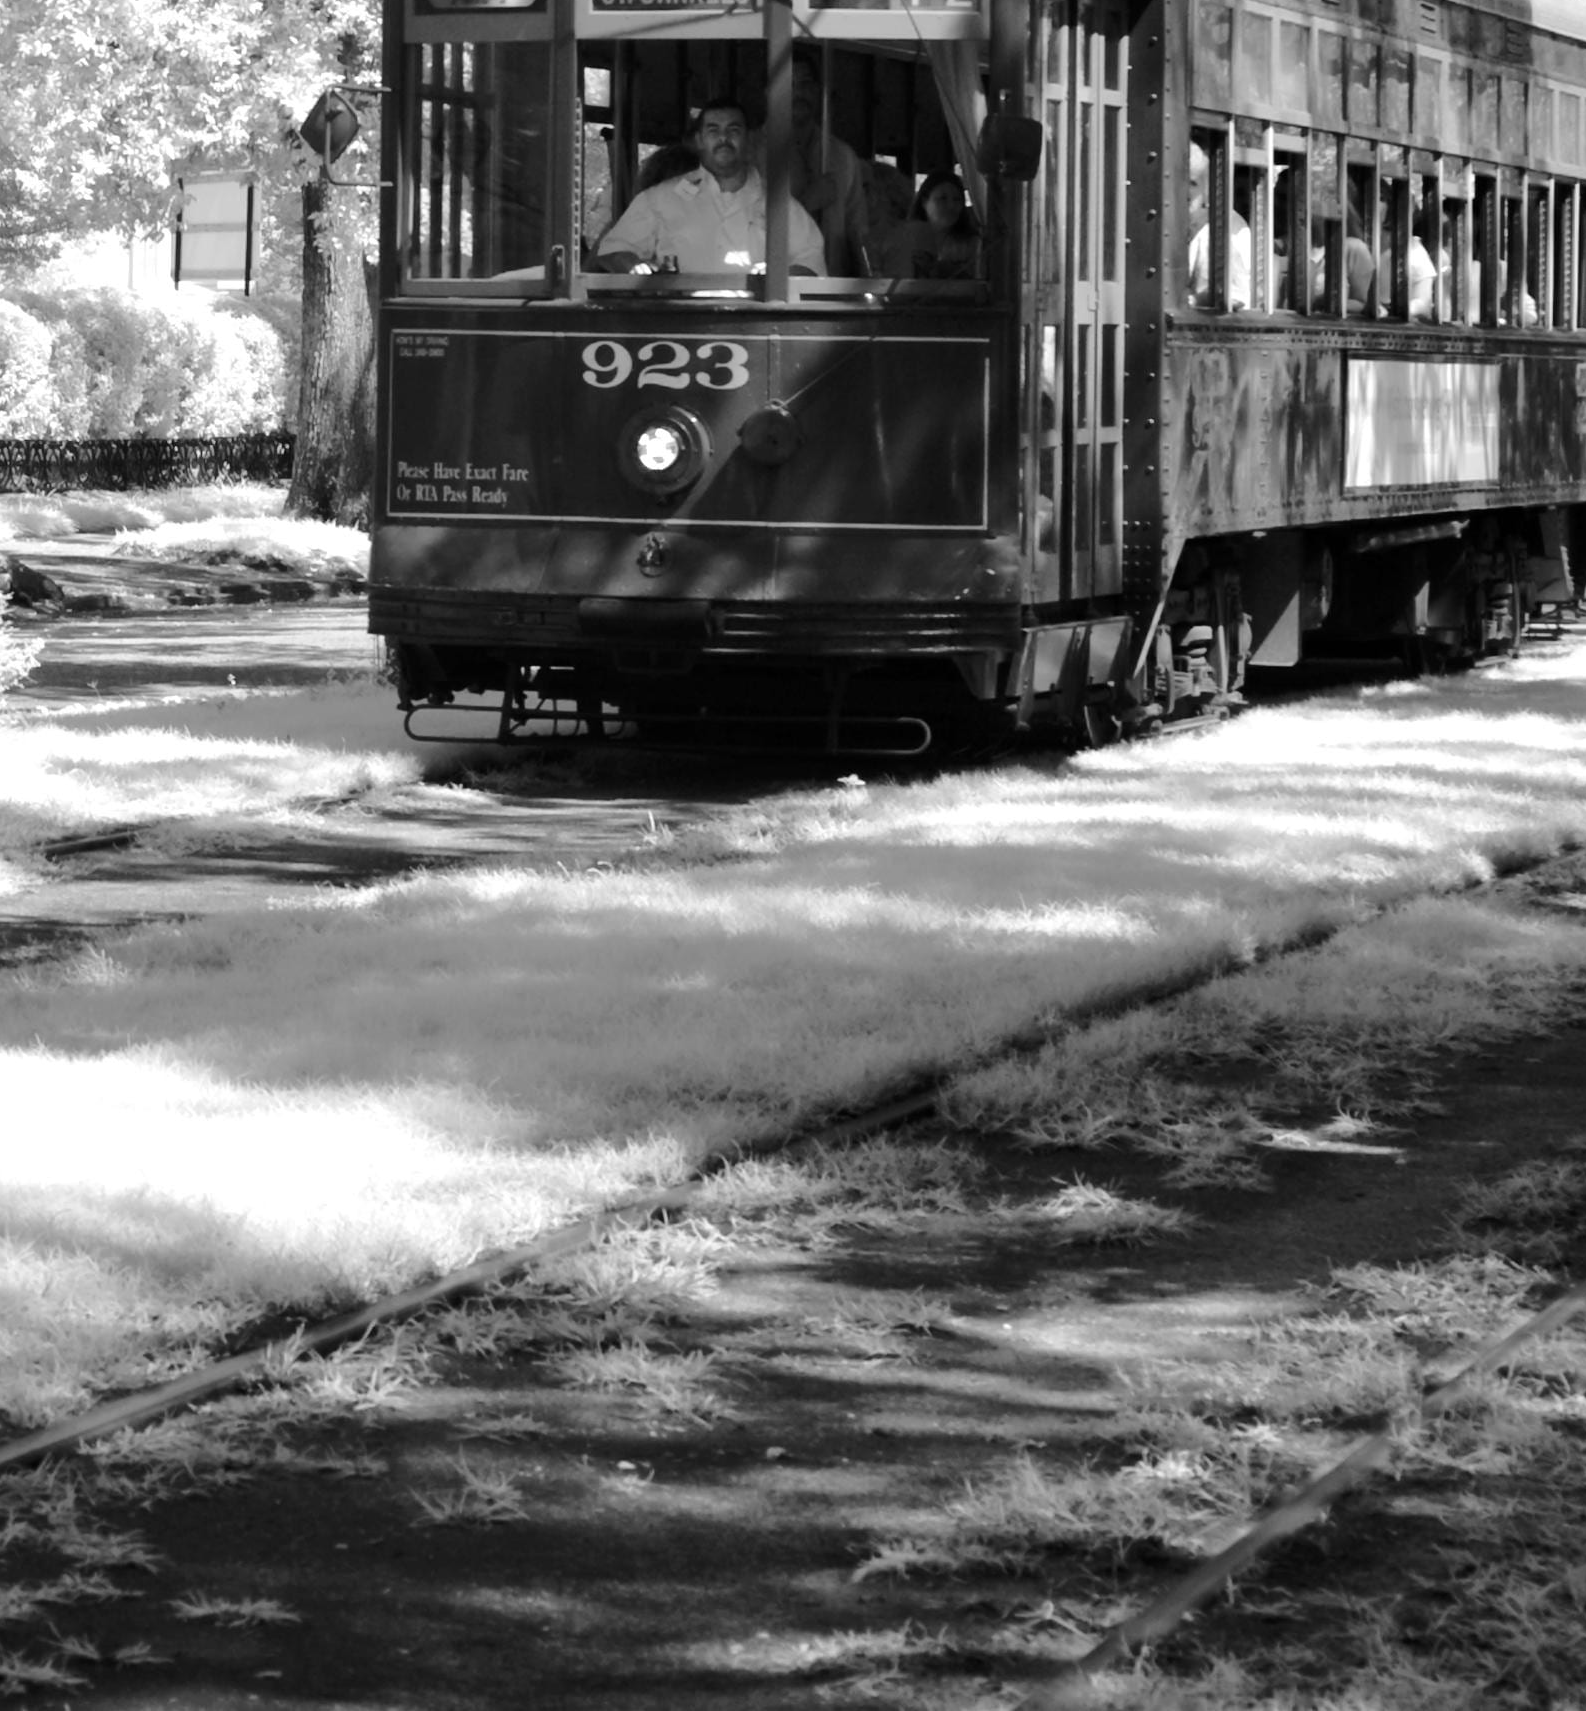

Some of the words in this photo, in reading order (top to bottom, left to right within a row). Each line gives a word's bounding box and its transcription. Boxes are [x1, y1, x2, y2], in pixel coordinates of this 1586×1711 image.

[581, 340, 750, 390] 923
[397, 461, 430, 479] Please
[433, 462, 461, 480] Have
[465, 463, 497, 480] Exact
[502, 463, 530, 482] Fare
[396, 484, 411, 501] Or
[415, 484, 438, 502] RTA
[443, 485, 468, 502] Pass
[472, 486, 508, 509] Ready
